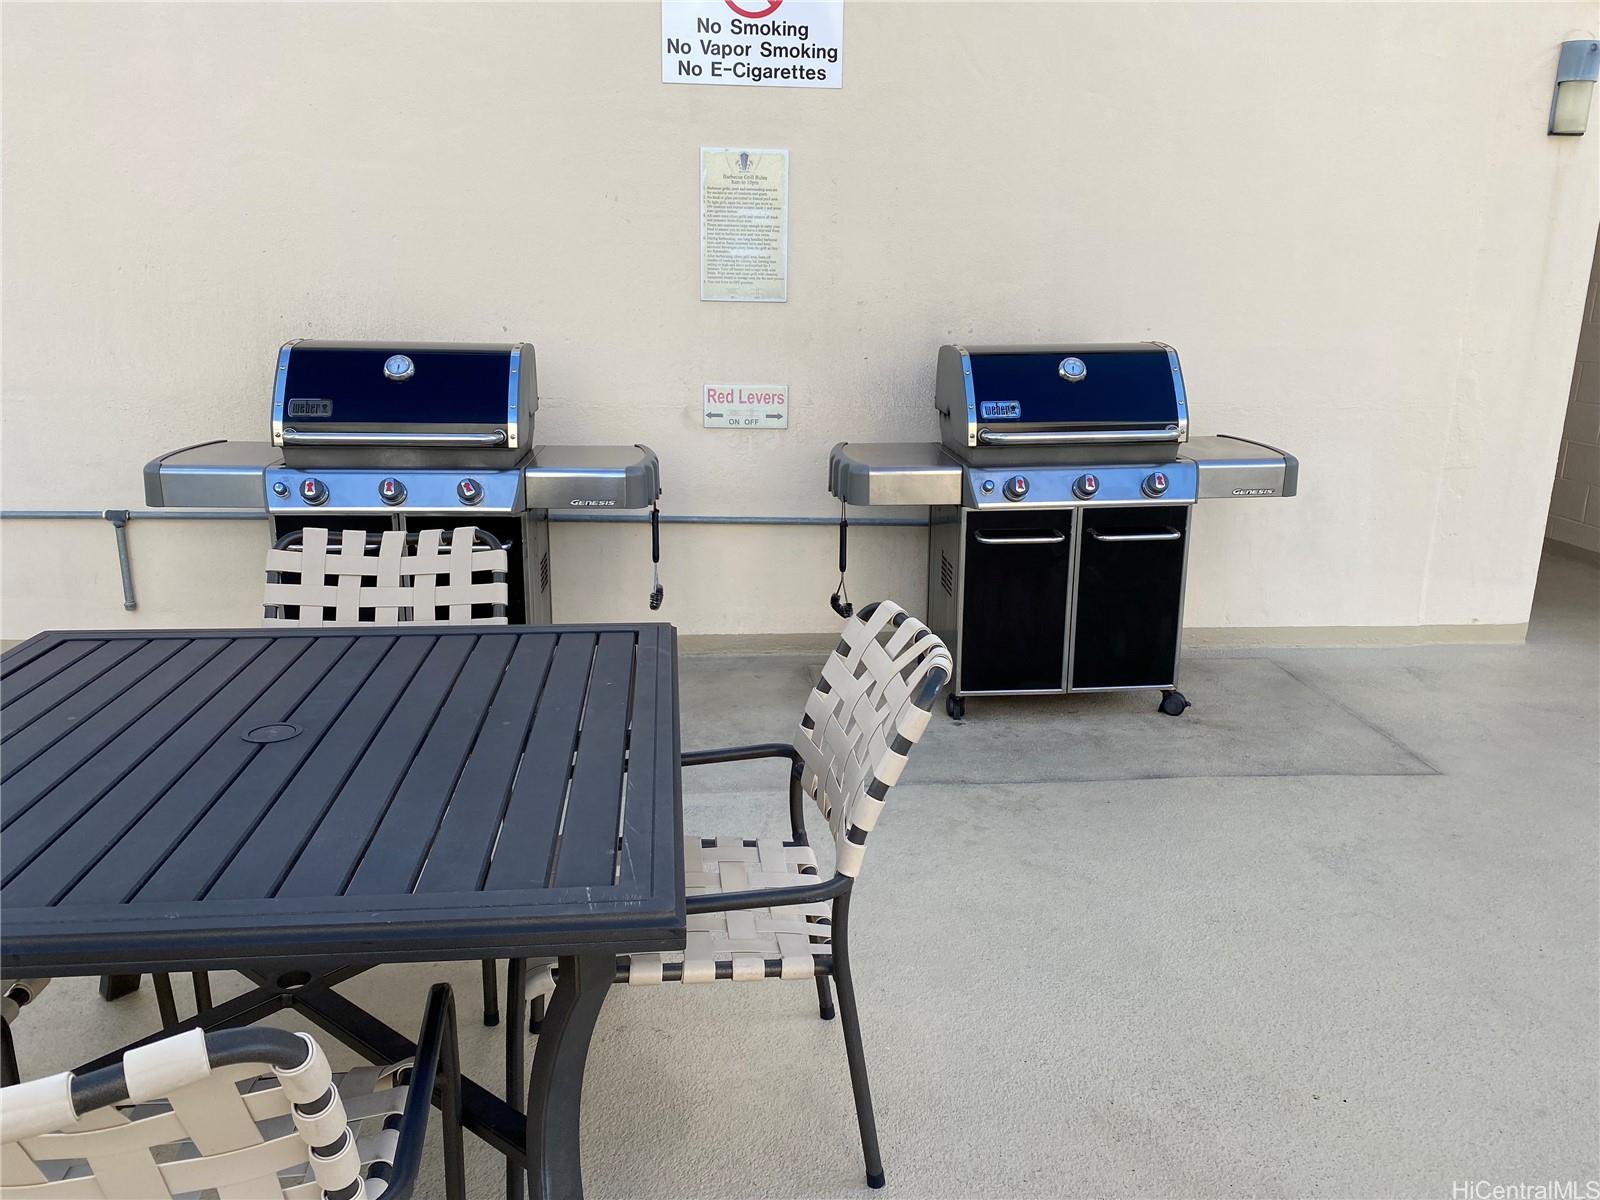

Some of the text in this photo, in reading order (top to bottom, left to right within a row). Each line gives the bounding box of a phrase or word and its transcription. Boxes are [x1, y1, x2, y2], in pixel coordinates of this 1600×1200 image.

[697, 17, 809, 40] No Smoking
[667, 38, 838, 63] No Vapor Smoking
[678, 60, 827, 82] No E-Cigarettes
[707, 388, 785, 405] Red Levers
[984, 402, 1010, 416] weber
[744, 418, 760, 426] OFF
